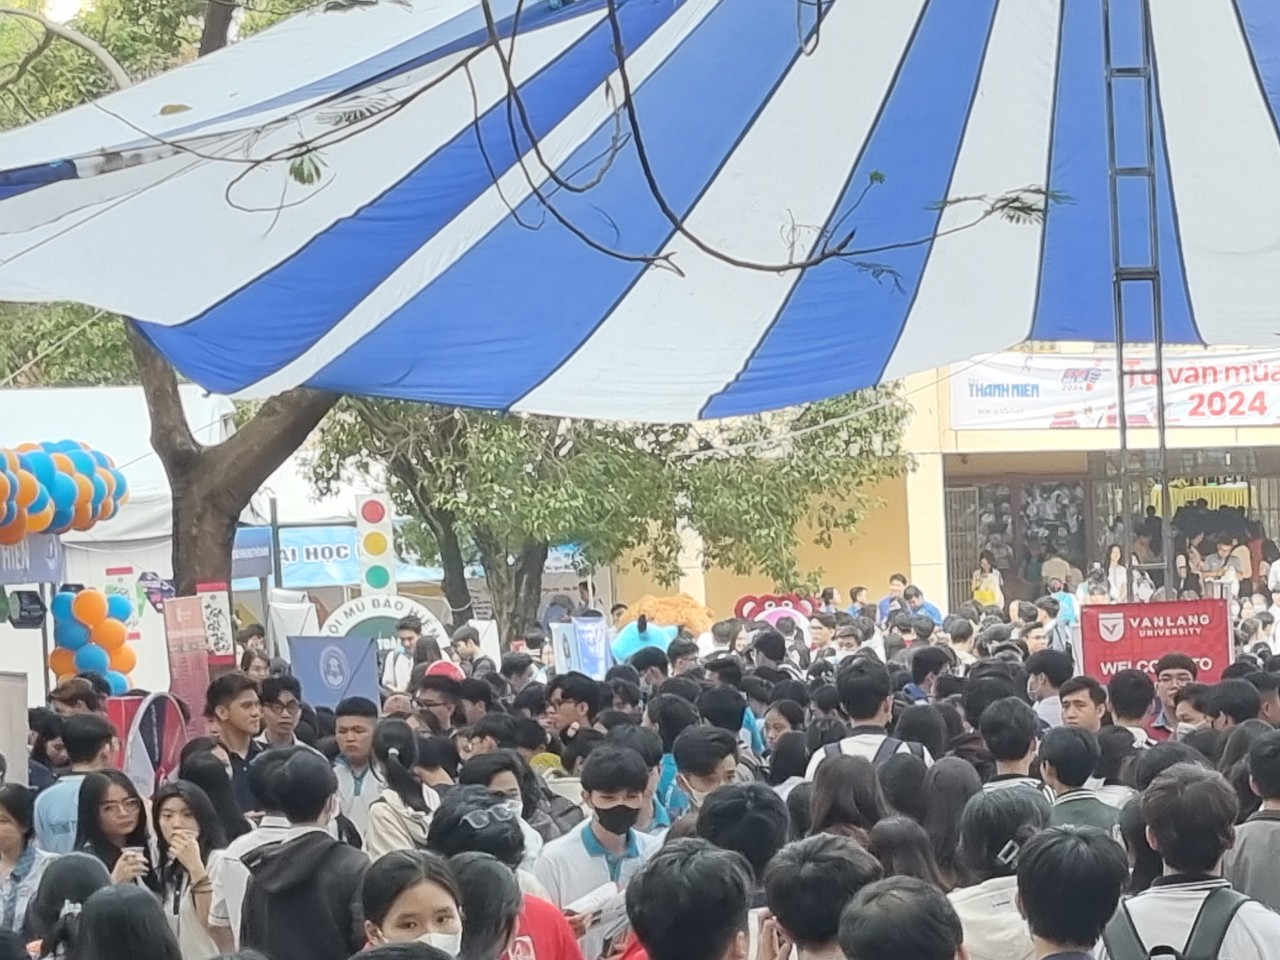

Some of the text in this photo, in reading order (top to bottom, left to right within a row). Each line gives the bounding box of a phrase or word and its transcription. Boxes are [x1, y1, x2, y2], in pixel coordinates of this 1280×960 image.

[1188, 390, 1268, 417] 2024
[304, 545, 349, 564] HỌC
[1139, 627, 1202, 637] UNIVERSITY
[1100, 659, 1159, 675] WELCO
